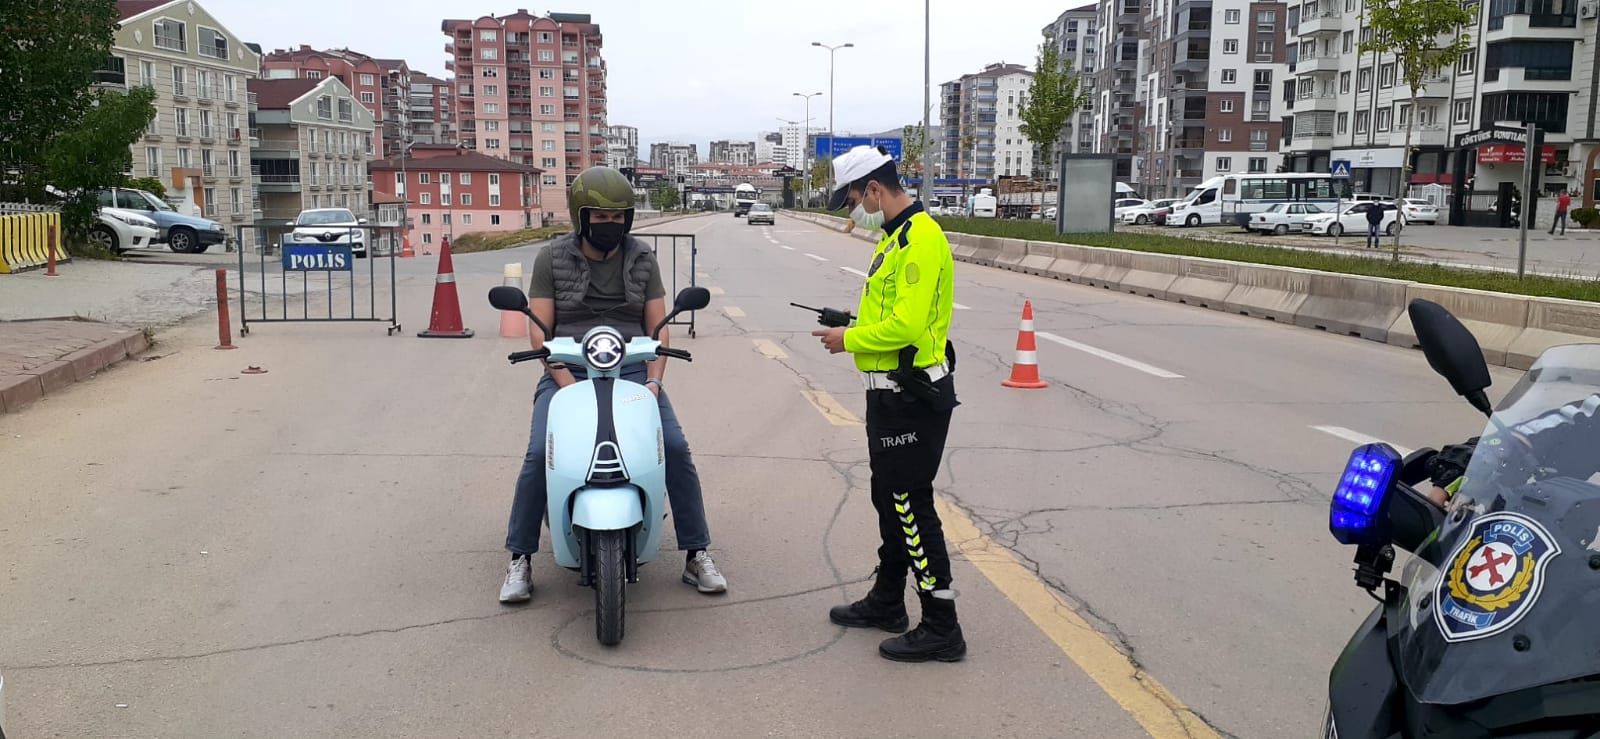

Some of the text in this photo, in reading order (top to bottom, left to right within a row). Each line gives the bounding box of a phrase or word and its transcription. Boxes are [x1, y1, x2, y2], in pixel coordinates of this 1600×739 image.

[290, 250, 345, 269] POLİS
[1494, 523, 1529, 541] POLİS
[1450, 606, 1477, 623] TRAFİK
